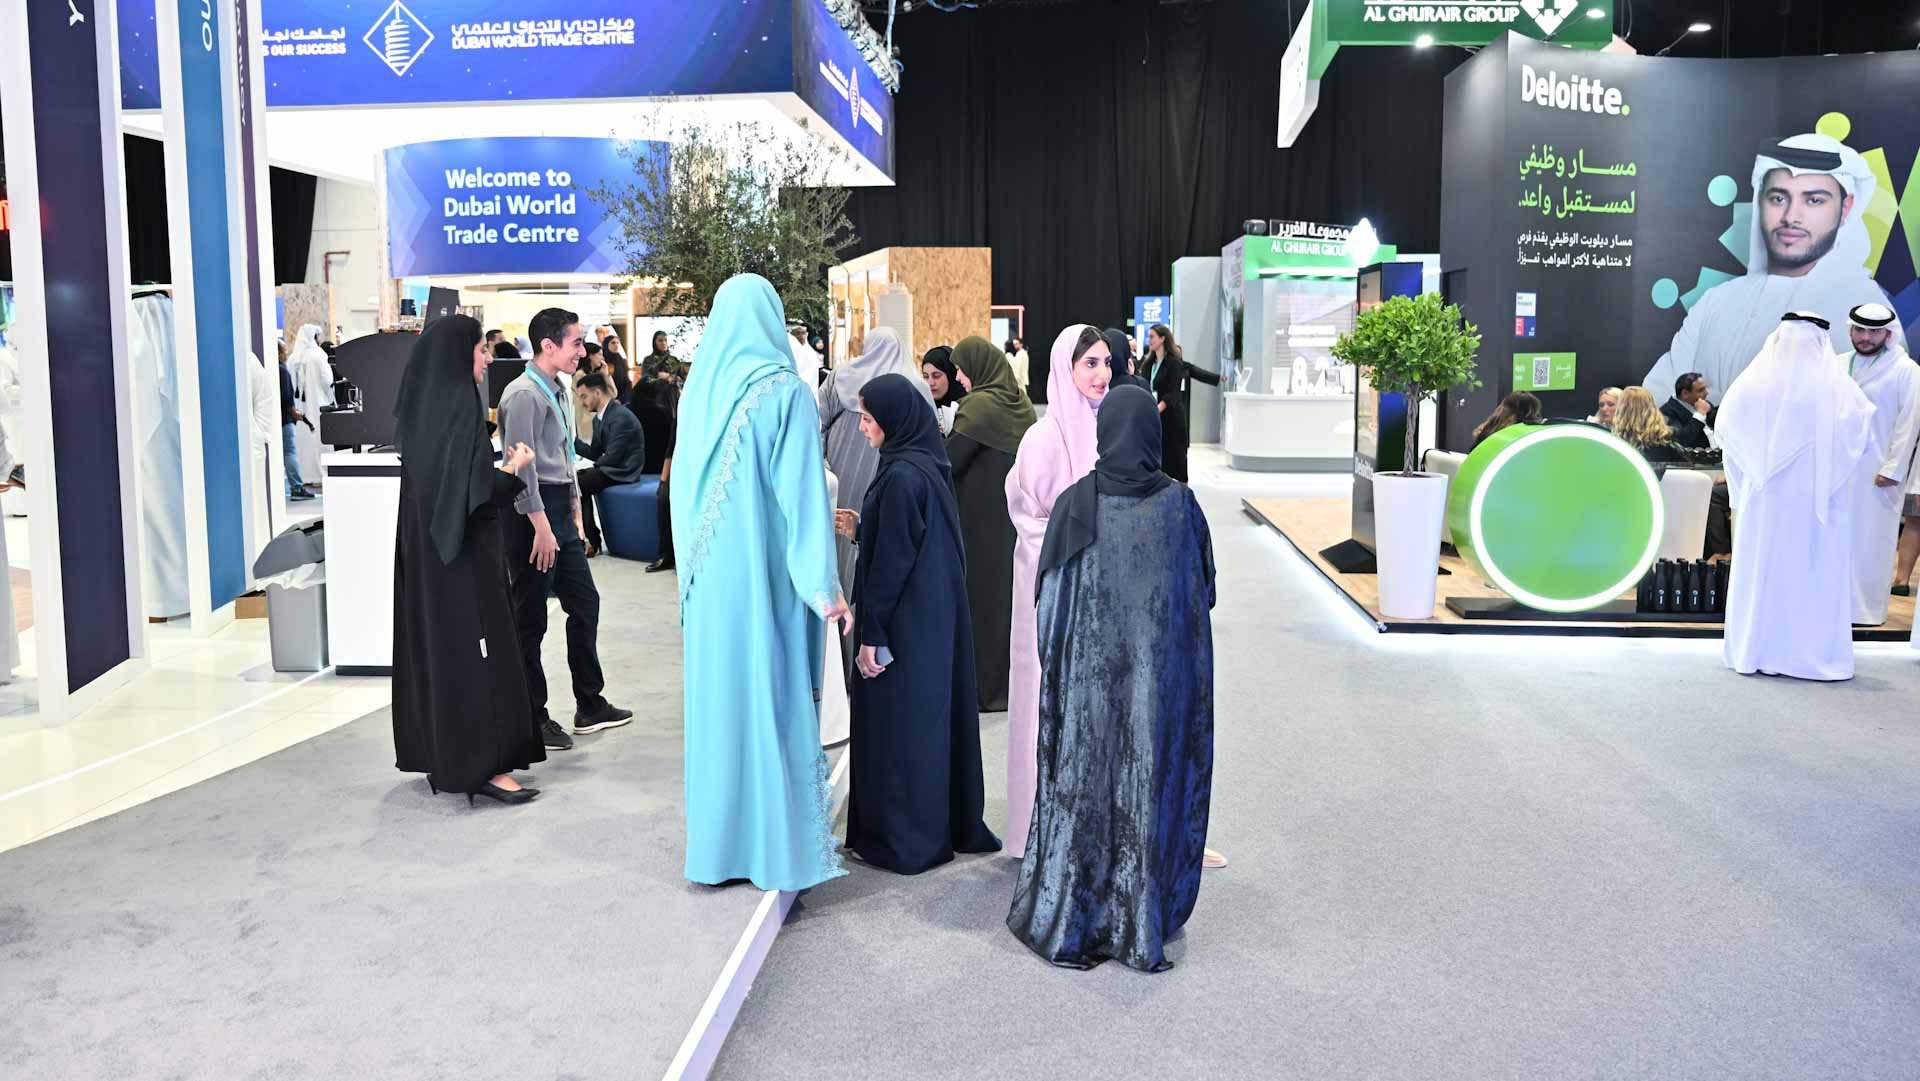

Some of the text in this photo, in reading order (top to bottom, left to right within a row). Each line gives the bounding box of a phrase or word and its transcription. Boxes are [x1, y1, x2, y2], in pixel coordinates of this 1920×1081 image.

[1364, 6, 1520, 22] AL GHURAIR GROUP
[271, 43, 296, 57] OUR
[296, 41, 347, 56] SUCCESS
[452, 30, 635, 50] DUBAI WORLD TRADE CENTRE
[1568, 148, 1637, 179] مسار
[445, 166, 571, 189] Welcome to
[443, 193, 577, 217] Dubai World
[1556, 187, 1636, 219] لمستقبل
[443, 222, 579, 245] Trade Centre
[1321, 244, 1347, 257] GROU
